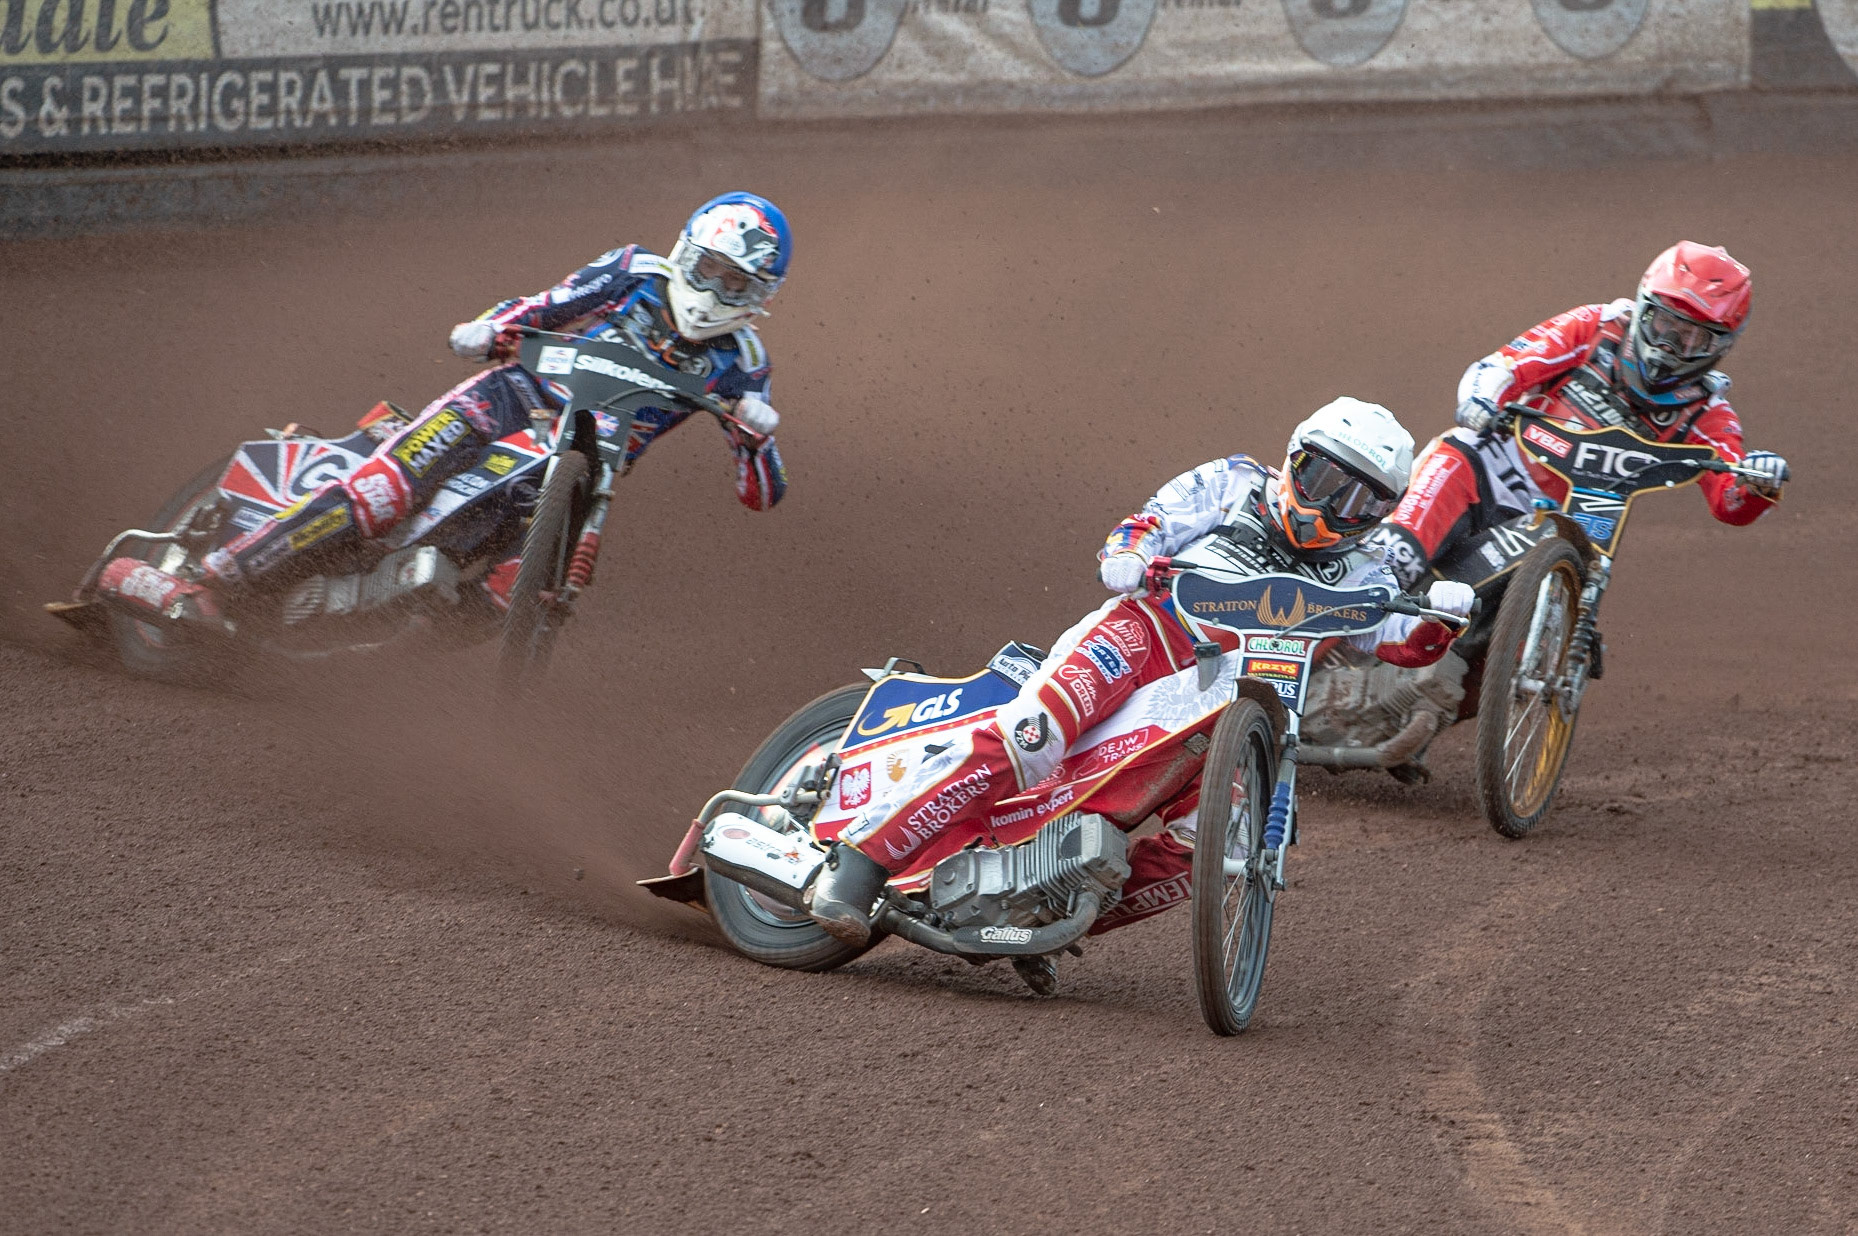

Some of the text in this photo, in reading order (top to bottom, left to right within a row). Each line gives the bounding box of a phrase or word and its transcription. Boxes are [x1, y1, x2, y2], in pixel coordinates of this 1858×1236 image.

[38, 75, 69, 138] &
[81, 65, 433, 136] REFRIGERATED
[442, 58, 639, 123] VEHICLE
[1528, 426, 1569, 457] VBG
[1573, 441, 1662, 478] FTC
[1193, 600, 1367, 622] STRATTON BROKERS
[911, 688, 964, 723] GLS
[1073, 681, 1094, 716] ORLEN
[1099, 734, 1139, 757] DEJW
[907, 763, 993, 831] STRATTON
[918, 780, 991, 841] BROKERS
[990, 807, 1035, 828] komin
